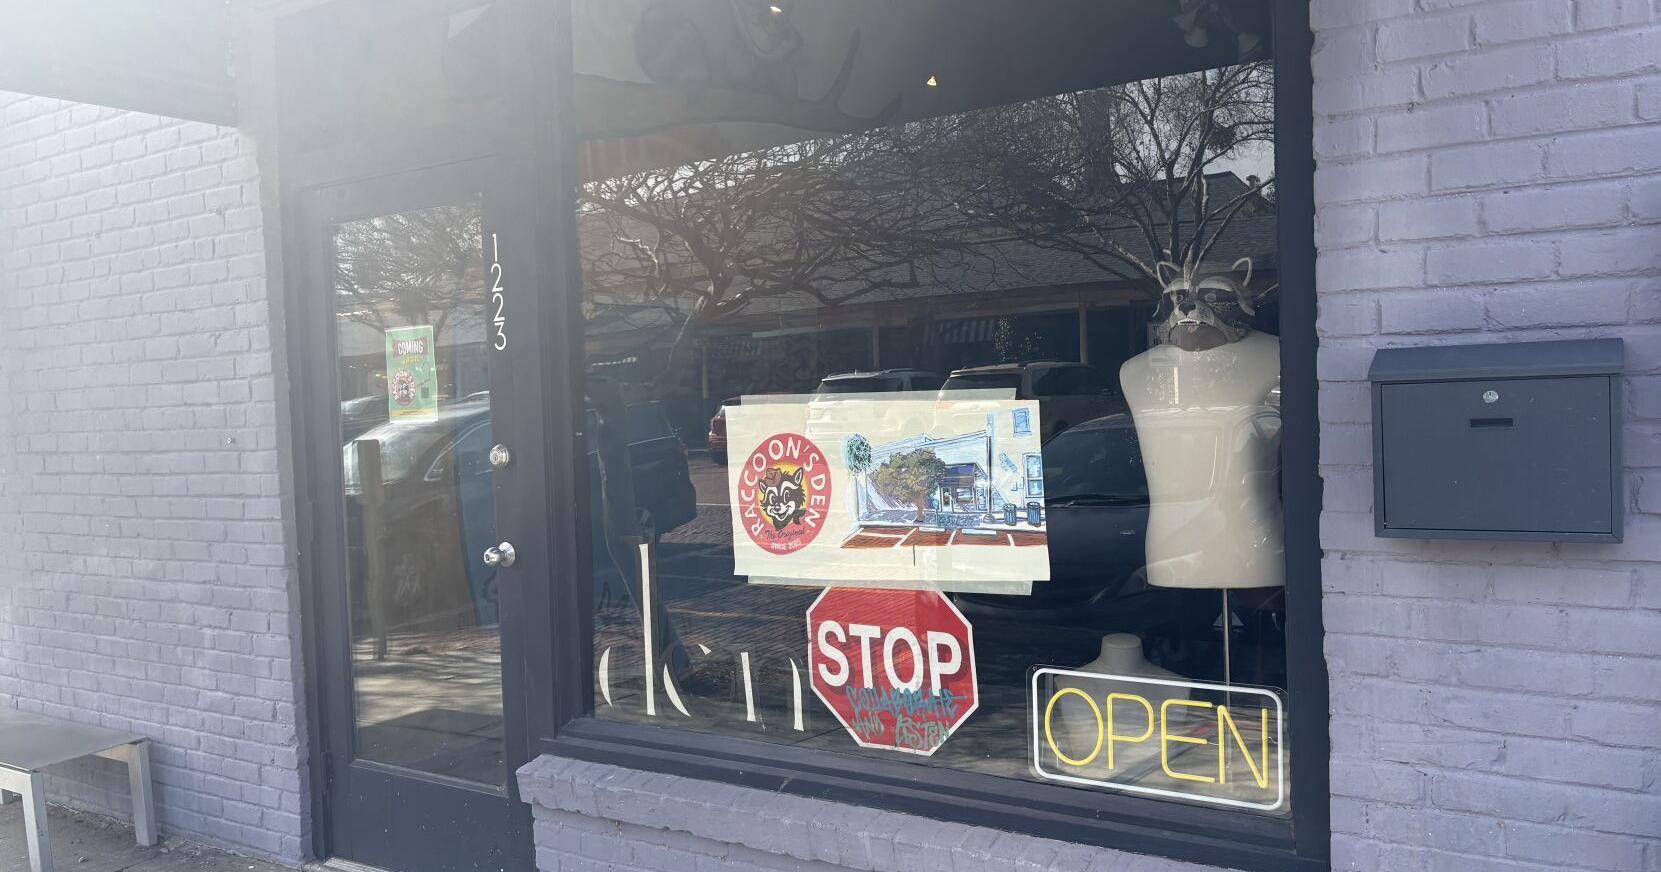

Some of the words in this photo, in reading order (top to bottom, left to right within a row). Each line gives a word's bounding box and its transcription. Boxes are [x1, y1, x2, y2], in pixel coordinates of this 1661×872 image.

[490, 233, 507, 351] 1223
[397, 340, 424, 355] COMING
[741, 437, 820, 536] RACCOON'S
[804, 473, 826, 528] DEN
[817, 620, 962, 698] STOP
[1044, 687, 1269, 789] OPEN
